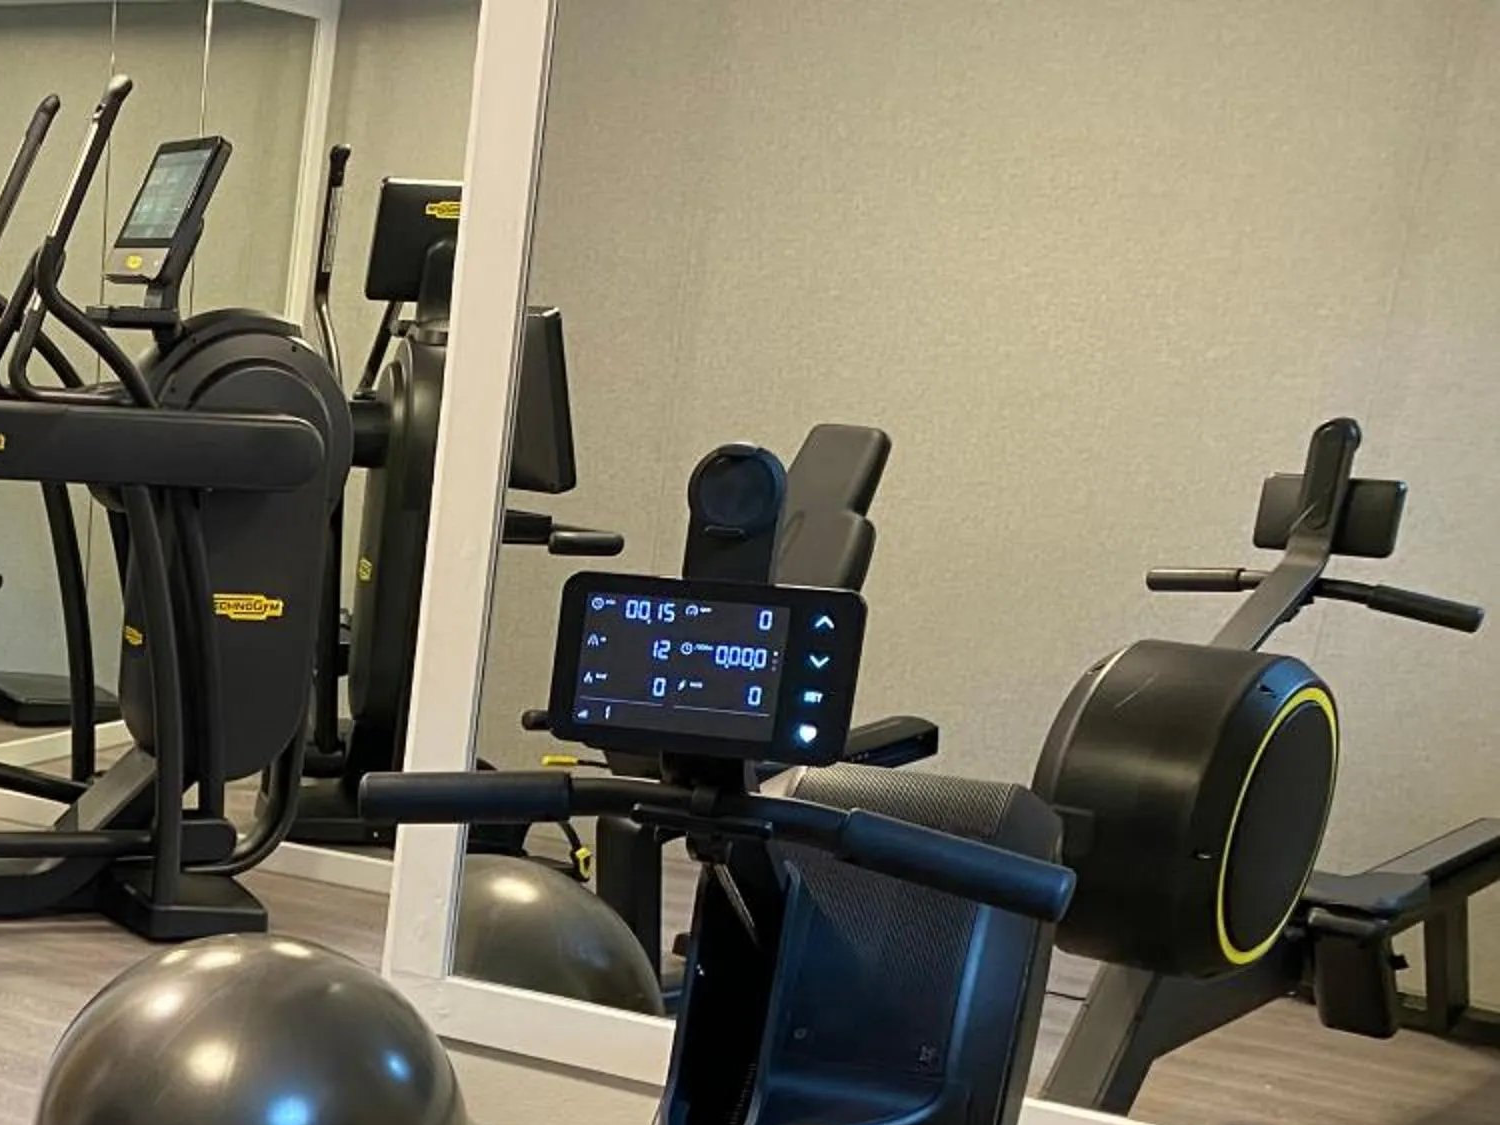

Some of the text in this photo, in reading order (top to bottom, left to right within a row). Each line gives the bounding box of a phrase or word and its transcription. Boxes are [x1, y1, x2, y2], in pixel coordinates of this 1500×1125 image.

[759, 609, 773, 631] 0
[653, 639, 671, 660] 12
[652, 677, 666, 697] 0
[747, 685, 762, 706] 0
